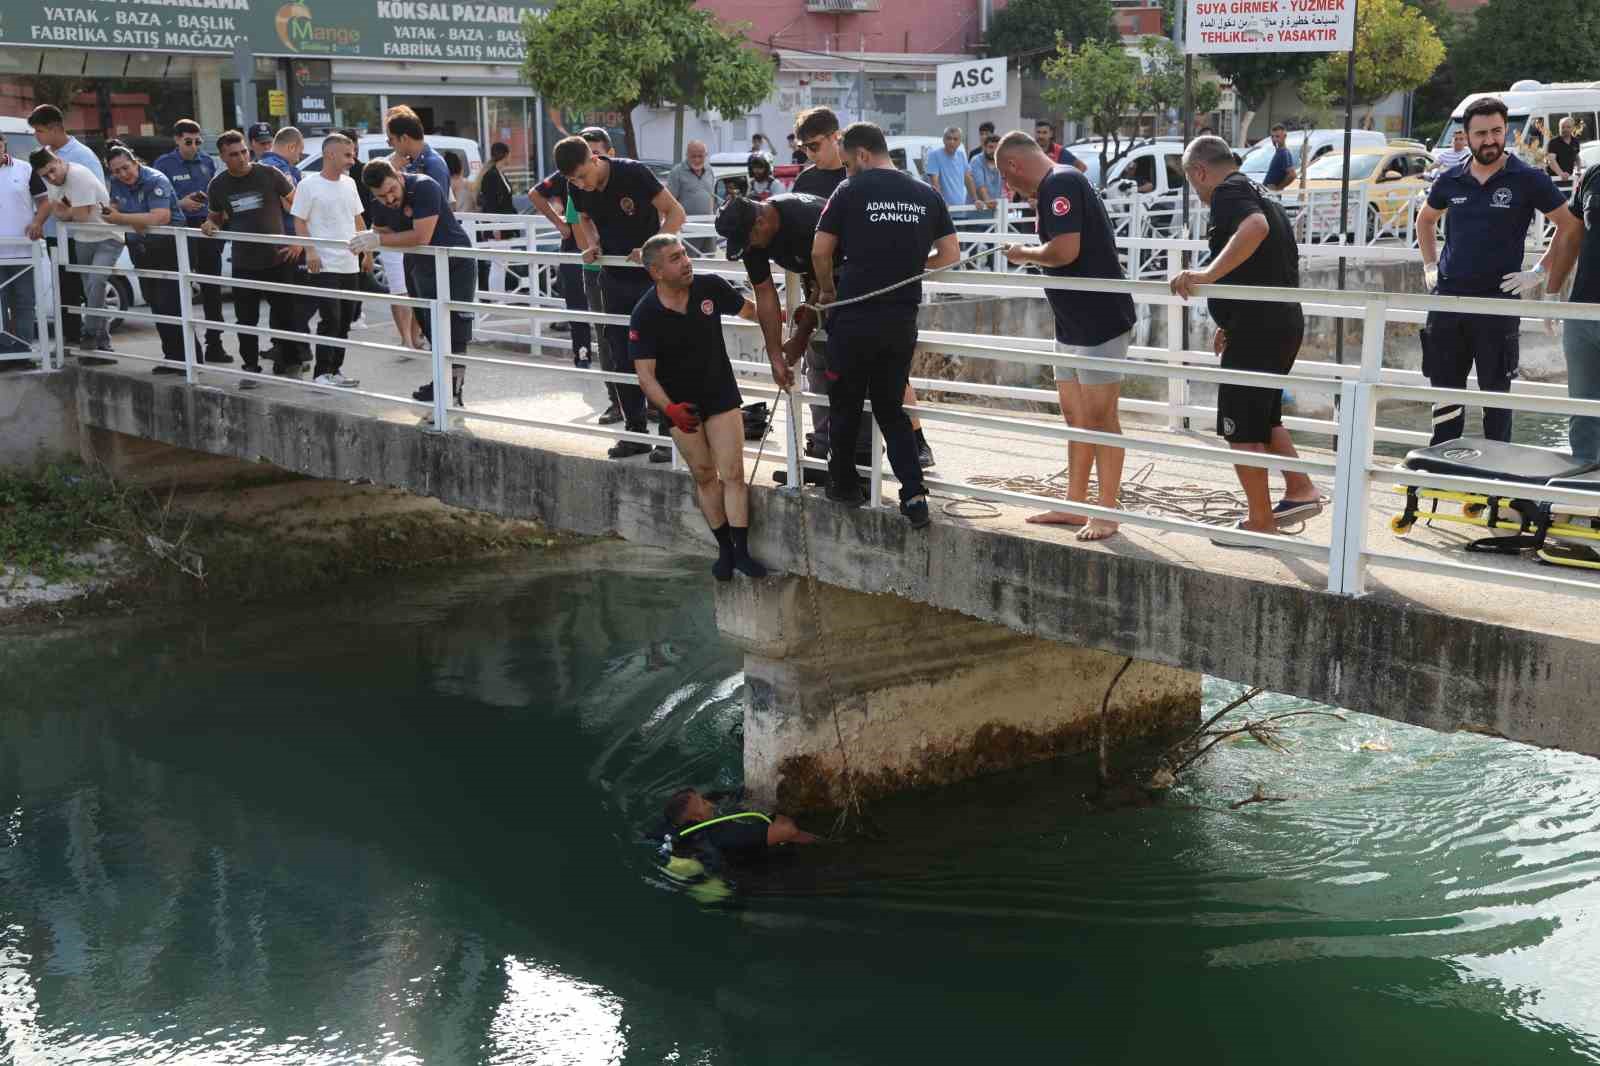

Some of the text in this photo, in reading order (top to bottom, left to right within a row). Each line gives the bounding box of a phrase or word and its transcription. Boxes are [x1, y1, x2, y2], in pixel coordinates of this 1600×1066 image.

[377, 0, 449, 20] KÖKSAL
[1196, 2, 1227, 15] SUYA
[1231, 0, 1278, 14] GİRMEK
[44, 7, 99, 23] YATAK
[115, 11, 161, 26] BAZA
[177, 15, 235, 32] BAŞLIK
[31, 24, 248, 48] FABRİKA SATIŞ MAĞAZA
[393, 26, 436, 40] YATAK
[449, 29, 484, 41] BAZA
[1278, 29, 1336, 41] YASAKTIR
[383, 40, 442, 57] FABRİKA
[446, 45, 482, 60] SATIŞ
[952, 67, 994, 89] ASC
[866, 202, 896, 212] ADANA
[870, 213, 919, 223] CANKUR
